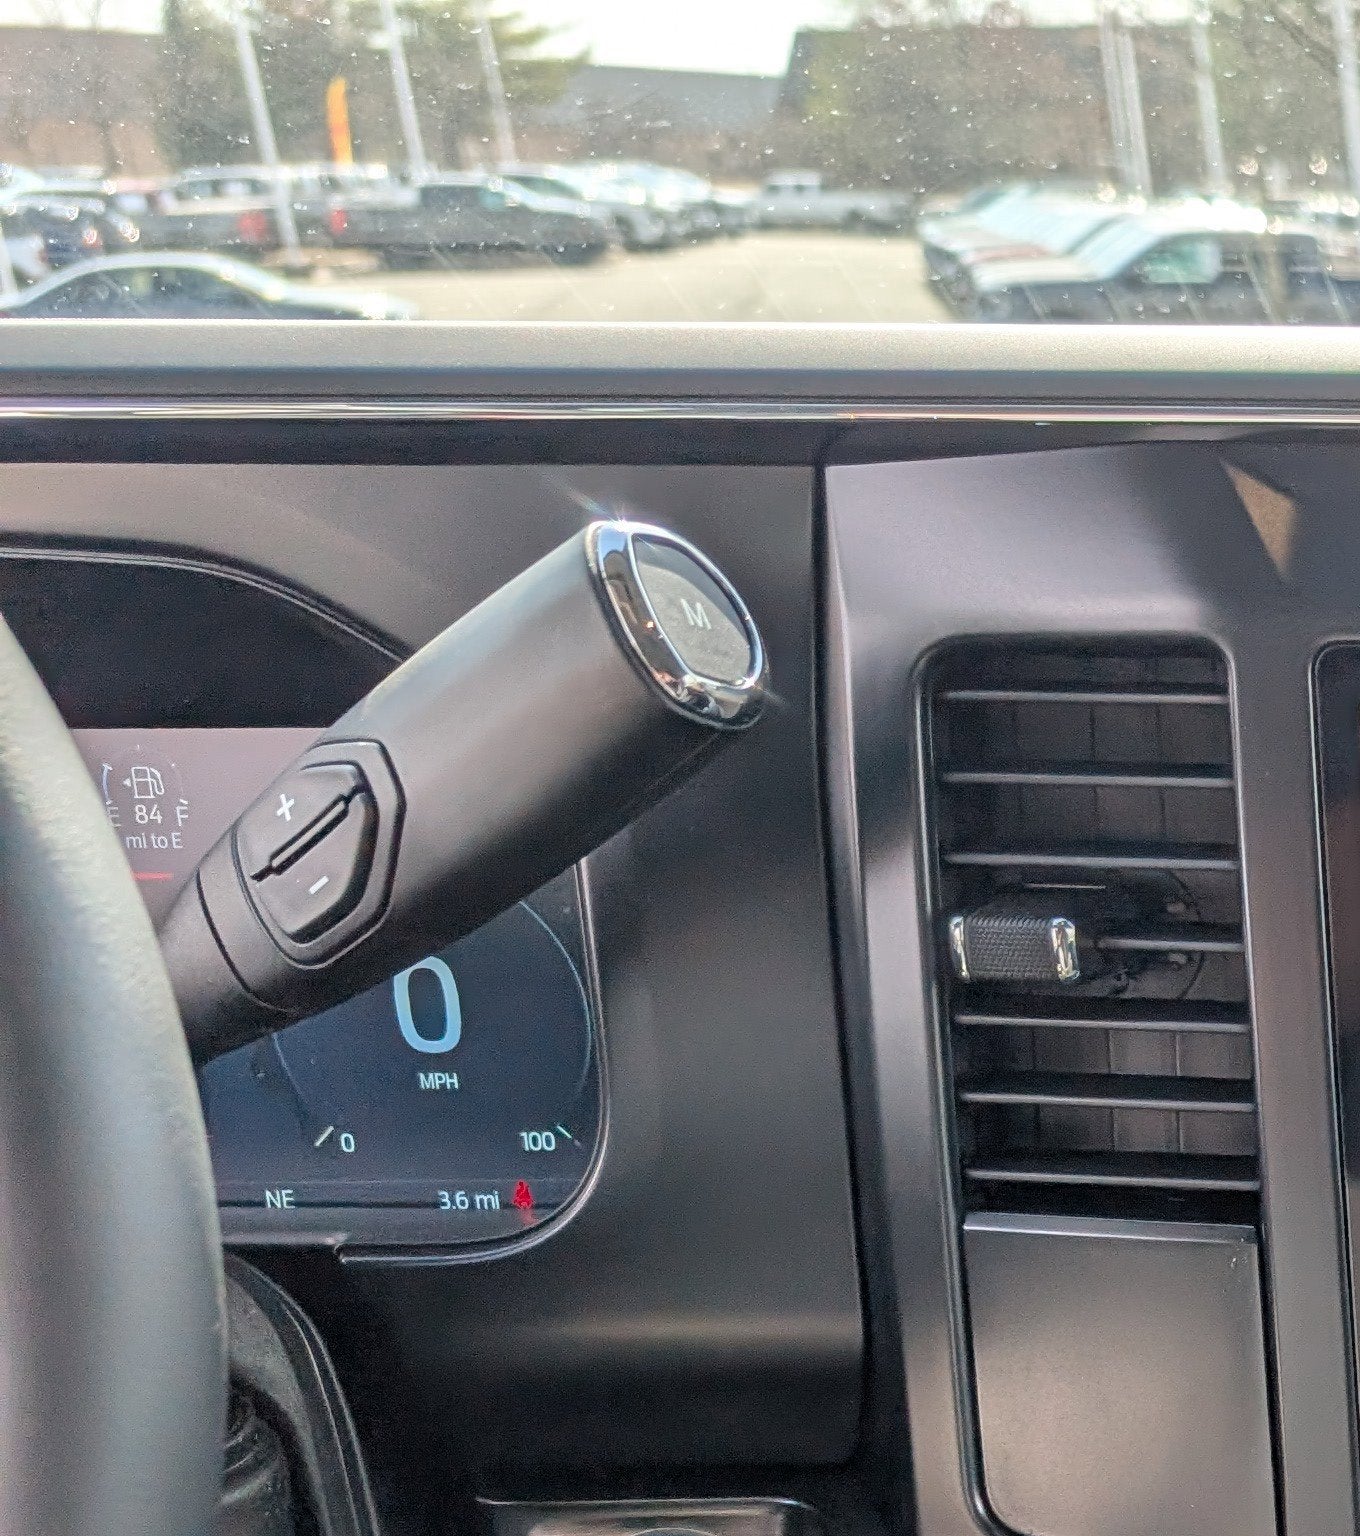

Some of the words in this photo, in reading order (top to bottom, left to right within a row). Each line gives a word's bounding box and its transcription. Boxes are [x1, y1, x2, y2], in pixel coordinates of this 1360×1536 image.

[680, 597, 713, 629] M
[135, 804, 162, 823] 84
[176, 806, 188, 826] F
[126, 833, 147, 848] mi
[151, 834, 168, 848] to
[172, 832, 182, 848] E
[393, 956, 461, 1053] 0
[419, 1073, 458, 1089] MPH
[341, 1133, 355, 1152] 0
[521, 1132, 555, 1151] 100
[263, 1190, 297, 1208] NE
[435, 1191, 468, 1209] 3.6
[475, 1191, 499, 1209] mi
